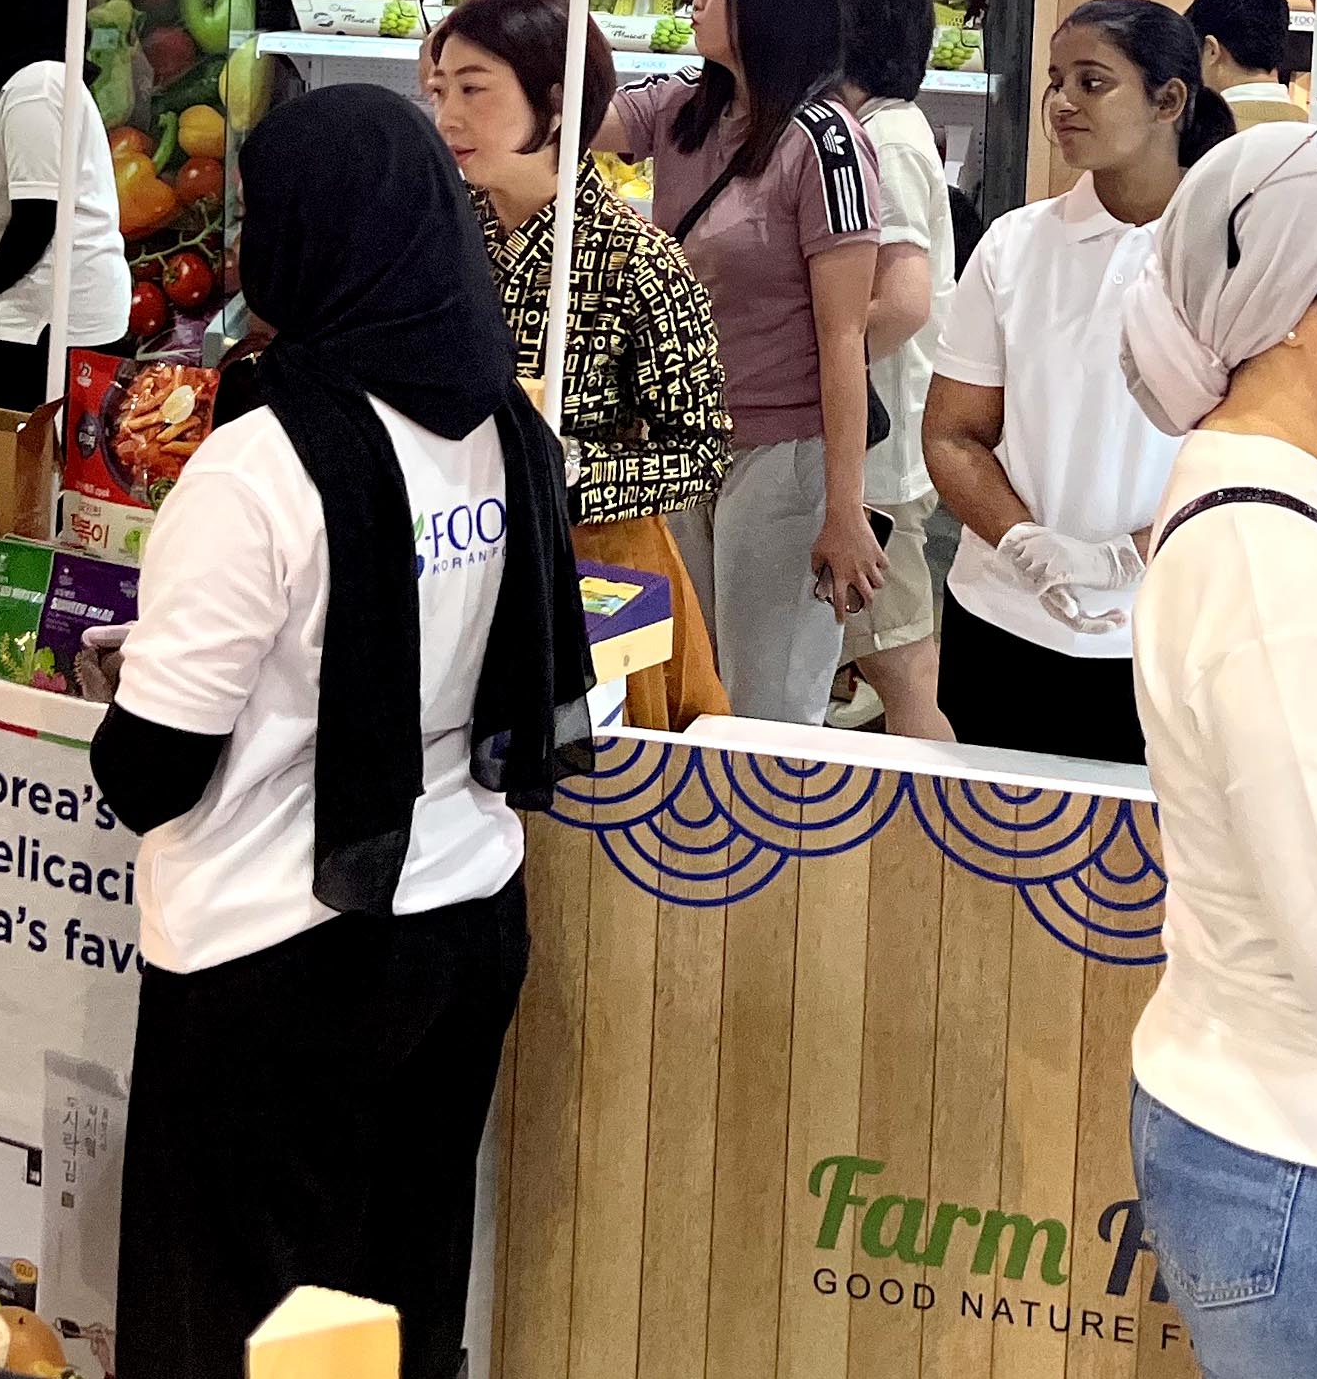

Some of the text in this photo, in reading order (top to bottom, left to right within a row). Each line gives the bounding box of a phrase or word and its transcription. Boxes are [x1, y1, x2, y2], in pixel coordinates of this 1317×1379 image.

[807, 1154, 1069, 1287] Farm
[813, 1268, 936, 1311] GOOD
[961, 1291, 1134, 1345] NATURE
